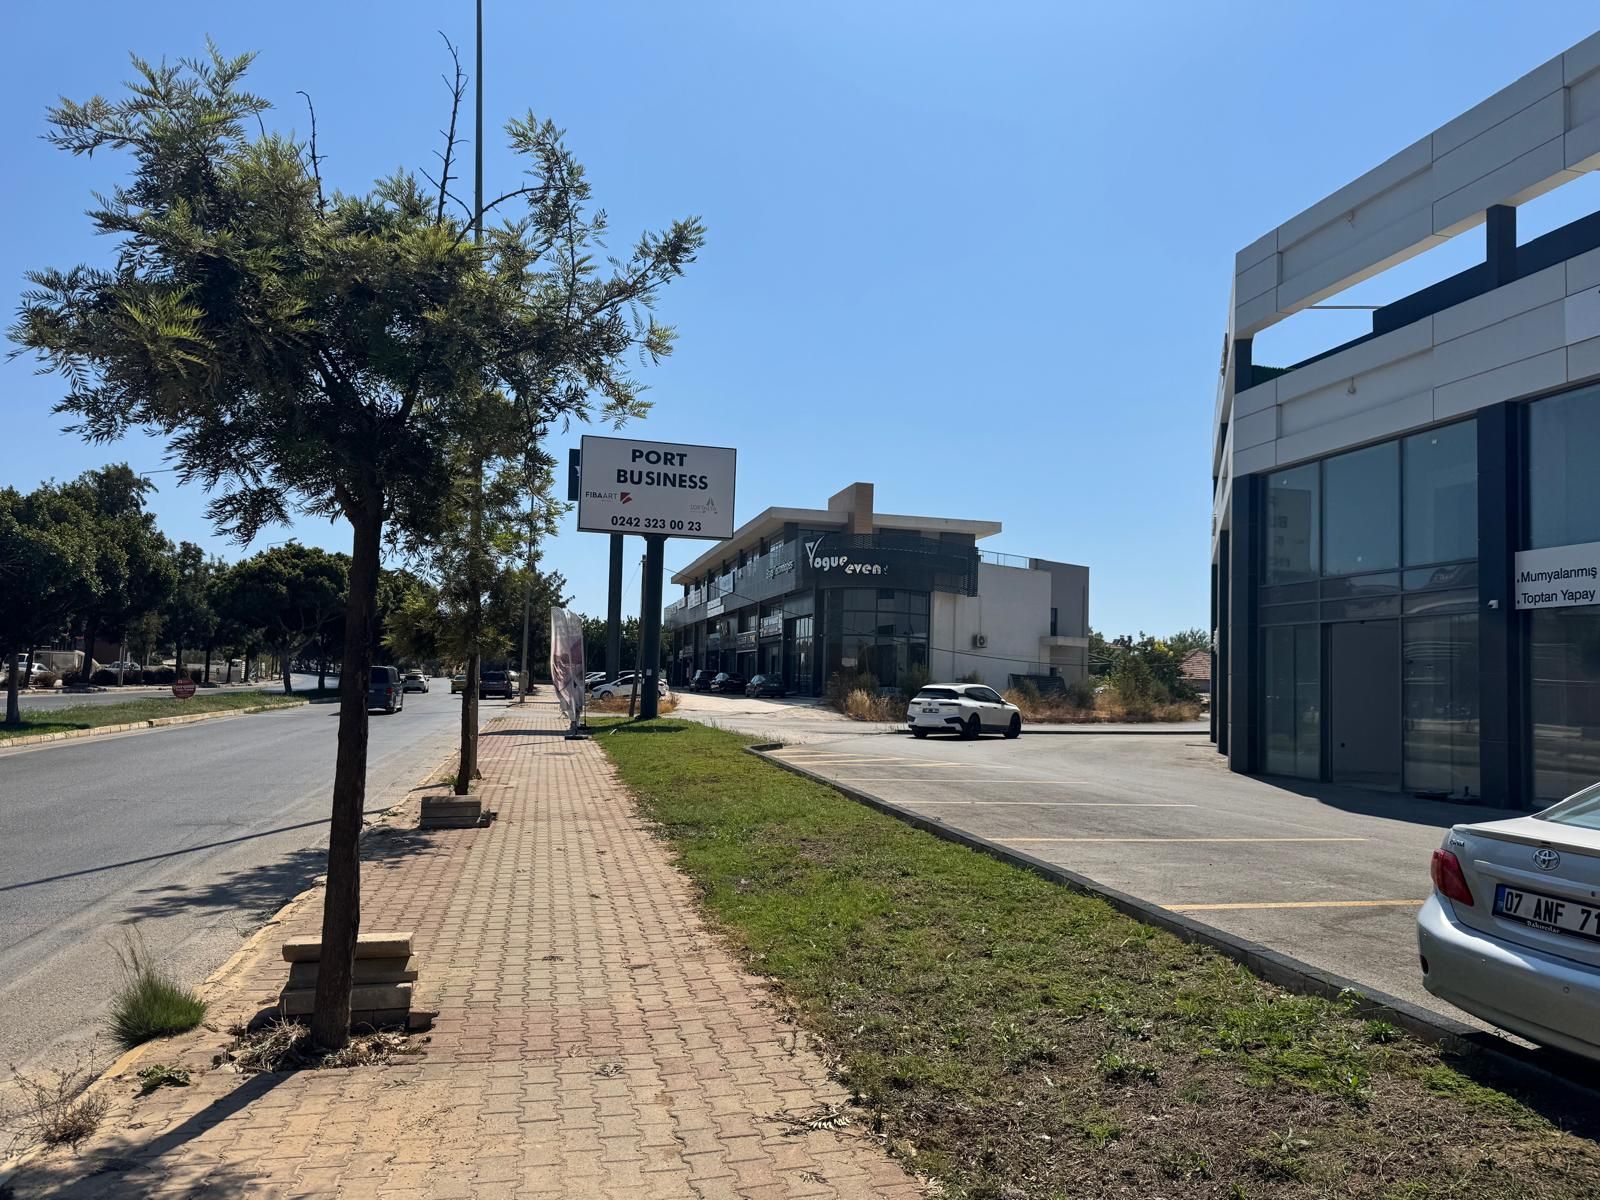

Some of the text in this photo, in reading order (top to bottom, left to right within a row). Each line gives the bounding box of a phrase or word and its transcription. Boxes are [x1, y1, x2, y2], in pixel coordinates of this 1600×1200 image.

[631, 449, 688, 467] PORT
[616, 469, 709, 490] BUSINESS
[611, 515, 702, 532] 0242 323 00 23
[804, 535, 848, 572] Vogue
[1520, 566, 1598, 584] Mumyalanmış
[1521, 589, 1596, 606] Toptan Yapay
[1504, 891, 1523, 914] 07
[1533, 898, 1566, 924] ANF
